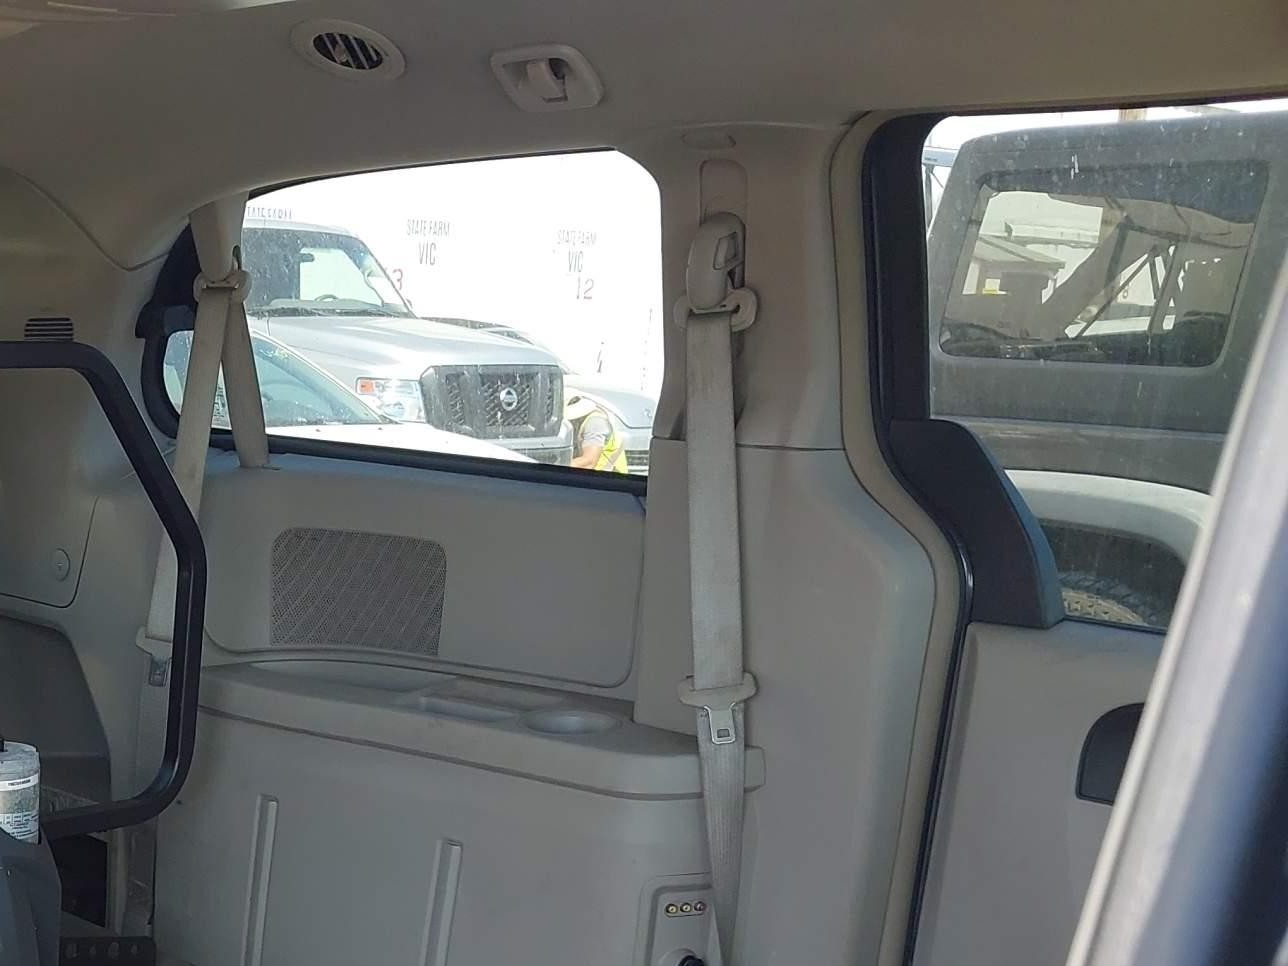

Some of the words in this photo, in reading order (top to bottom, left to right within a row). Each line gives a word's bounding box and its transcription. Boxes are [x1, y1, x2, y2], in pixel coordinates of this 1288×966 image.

[406, 218, 427, 237] STATE
[428, 219, 451, 238] FARM
[418, 239, 437, 266] VIC
[568, 248, 584, 273] VIC
[576, 276, 595, 300] 12
